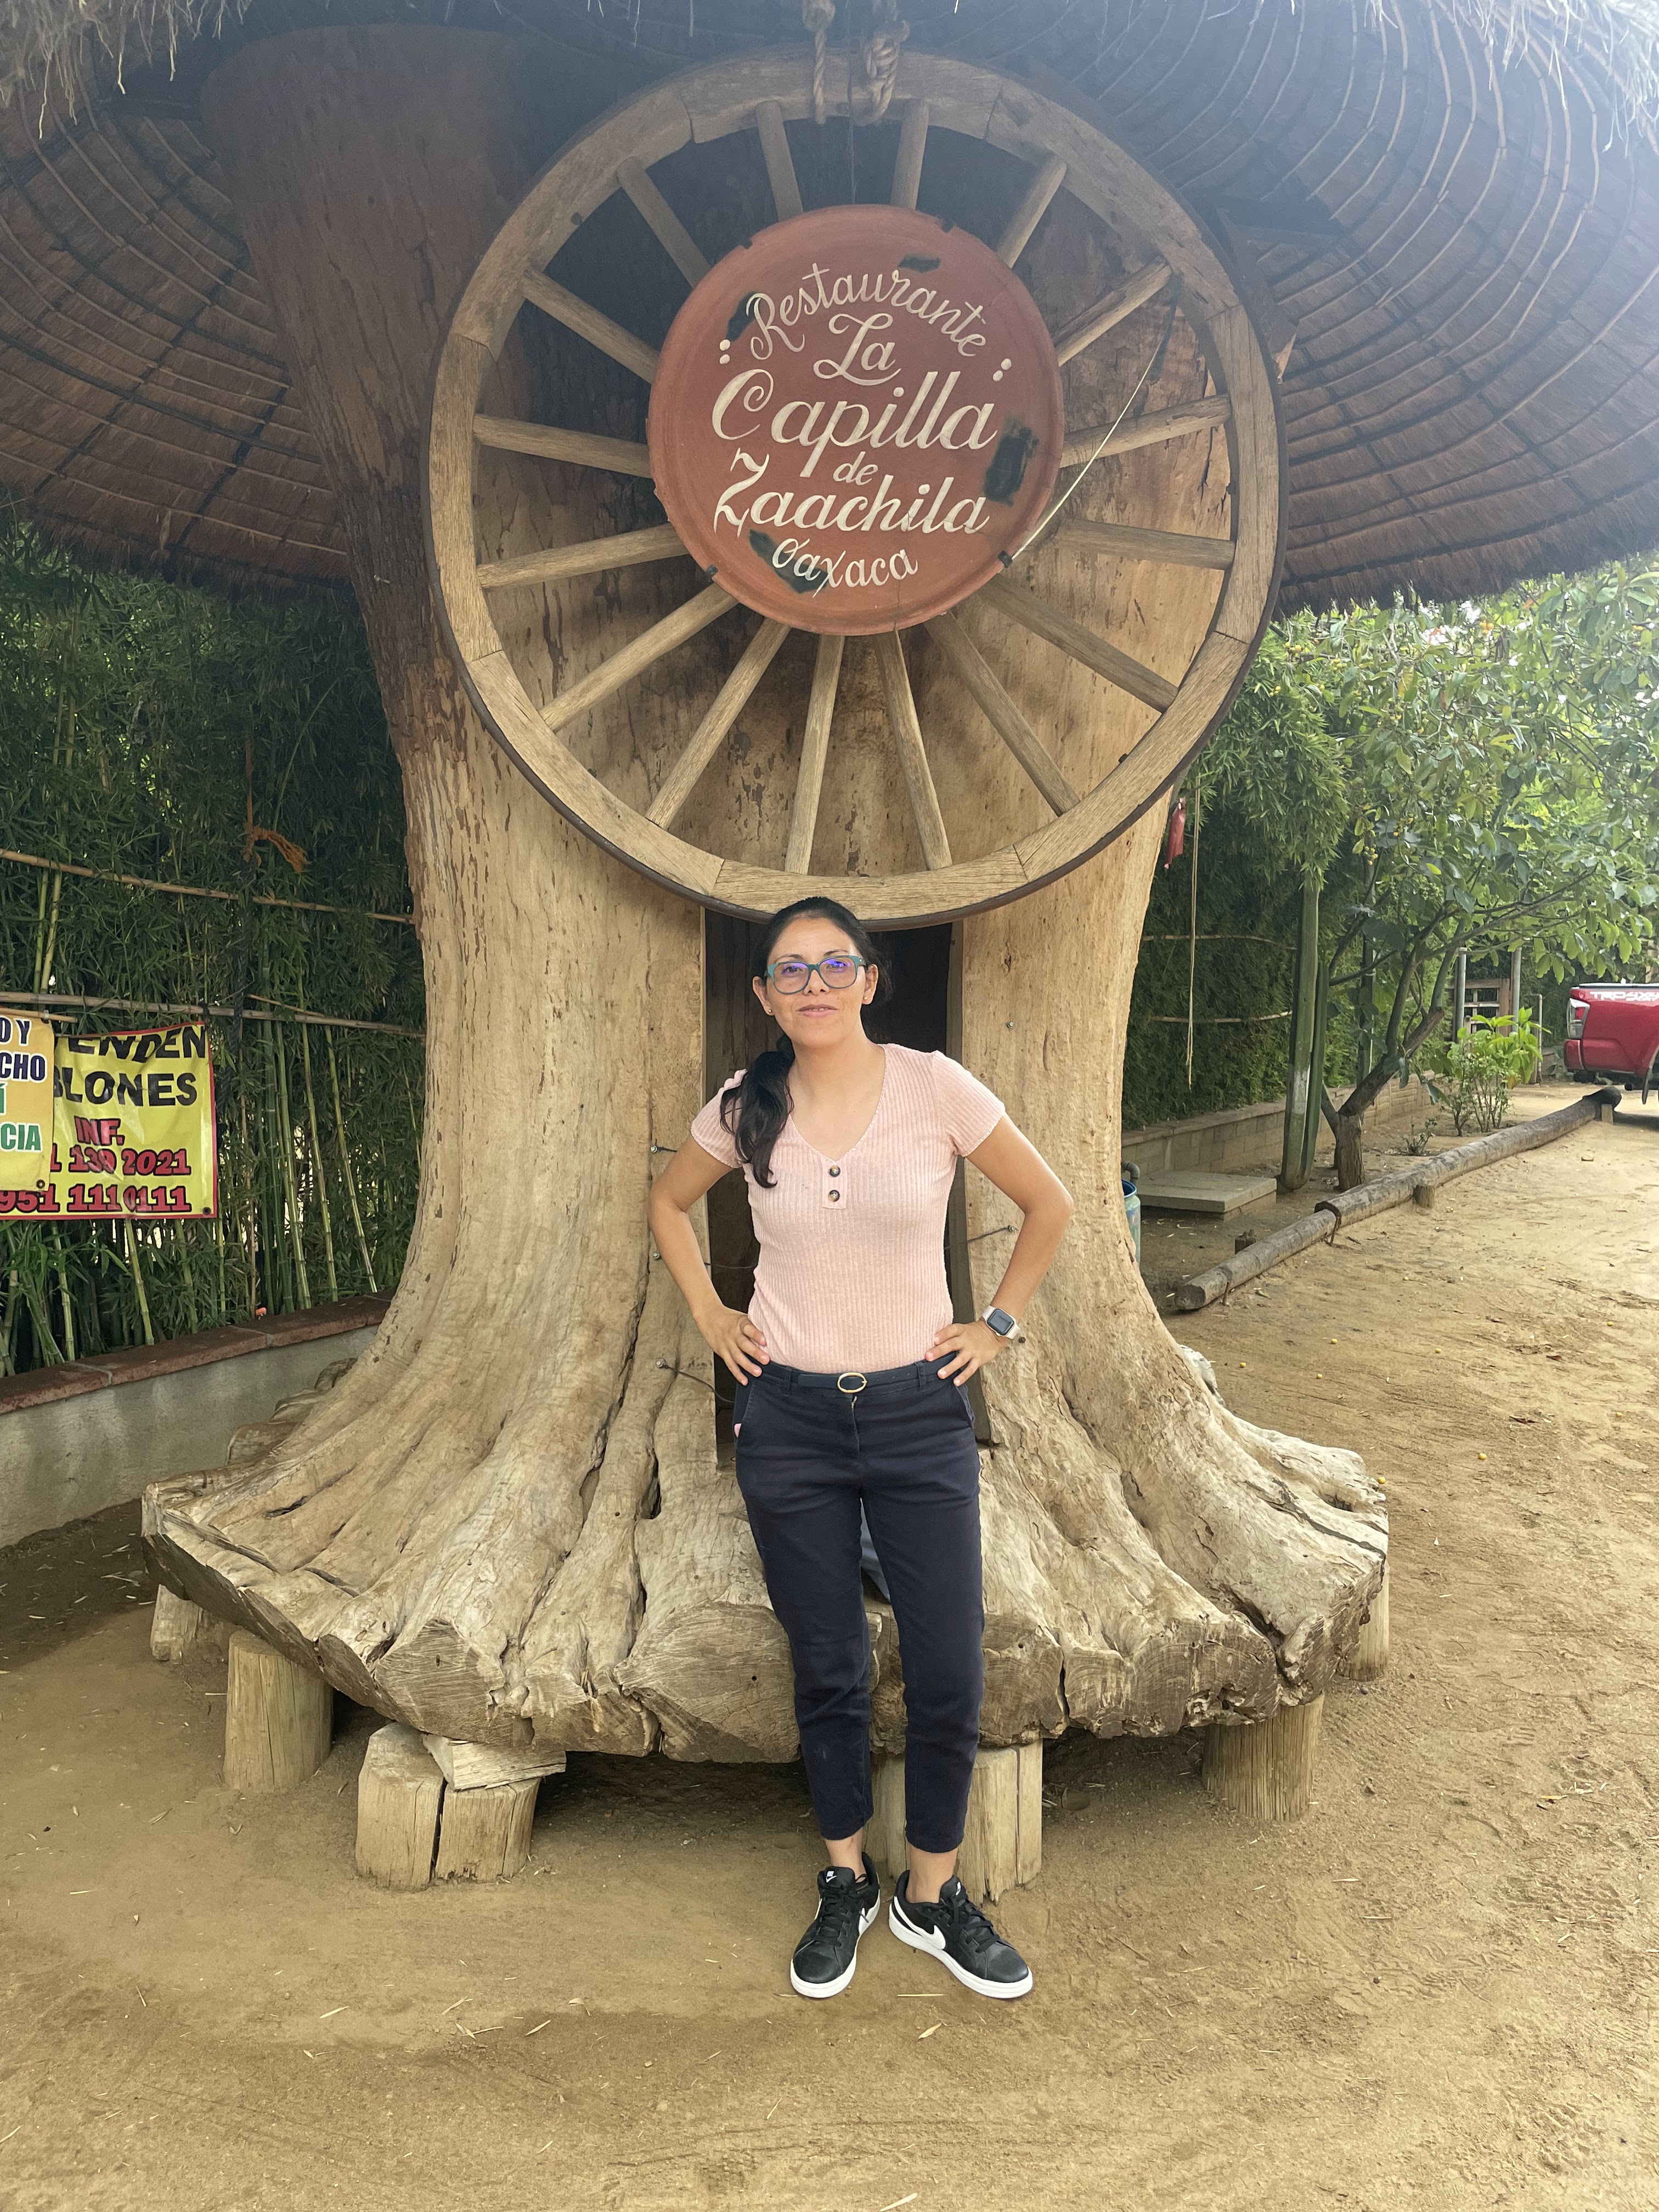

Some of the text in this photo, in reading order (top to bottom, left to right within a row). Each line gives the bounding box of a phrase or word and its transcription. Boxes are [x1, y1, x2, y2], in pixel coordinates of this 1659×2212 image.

[746, 263, 986, 360] Restaurante
[813, 313, 902, 386] La
[712, 369, 998, 478] Capilla
[713, 448, 990, 538] Zaachila
[833, 451, 879, 486] de
[74, 1115, 125, 1146] INF.
[121, 1148, 191, 1176] 2021
[66, 1183, 123, 1212] 111
